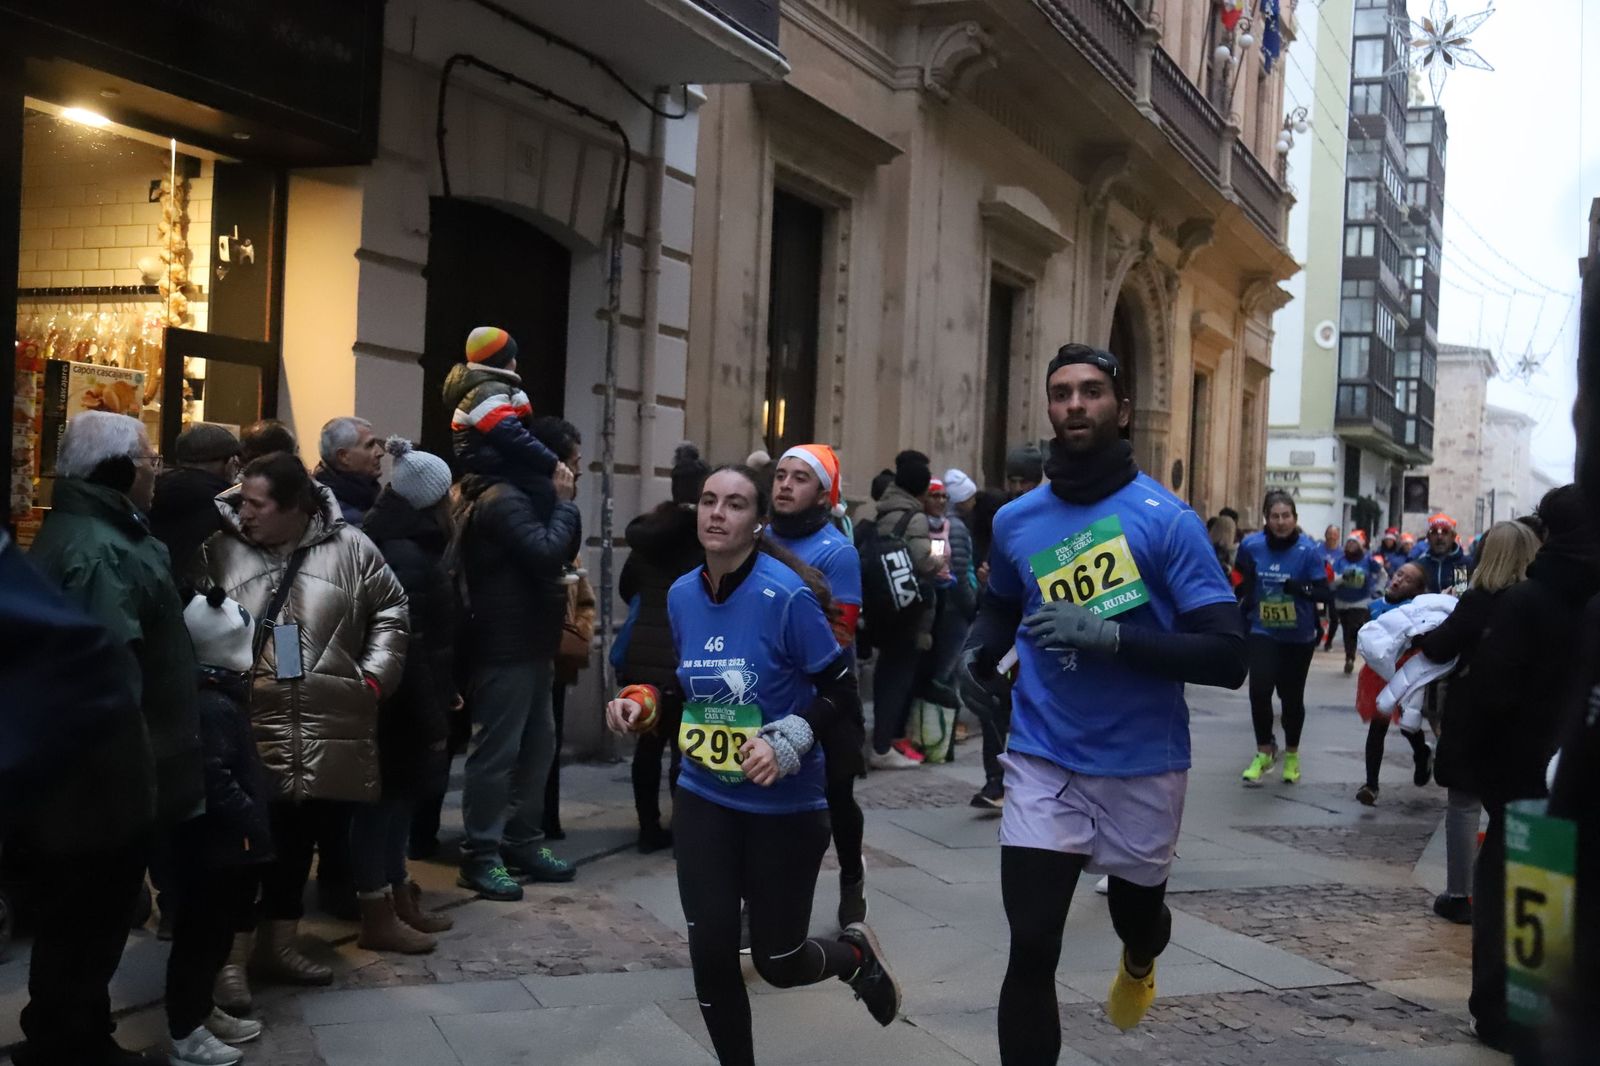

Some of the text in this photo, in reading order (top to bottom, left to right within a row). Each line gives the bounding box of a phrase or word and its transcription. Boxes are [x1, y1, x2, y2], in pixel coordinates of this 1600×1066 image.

[97, 369, 132, 381] cascajares
[886, 550, 916, 607] FILA
[1049, 552, 1124, 603] 962
[1103, 590, 1142, 608] RURAL
[1263, 605, 1289, 621] 551
[704, 636, 725, 653] 46
[694, 659, 728, 667] SILVESTRE
[686, 729, 748, 766] 293
[1515, 886, 1547, 968] 5
